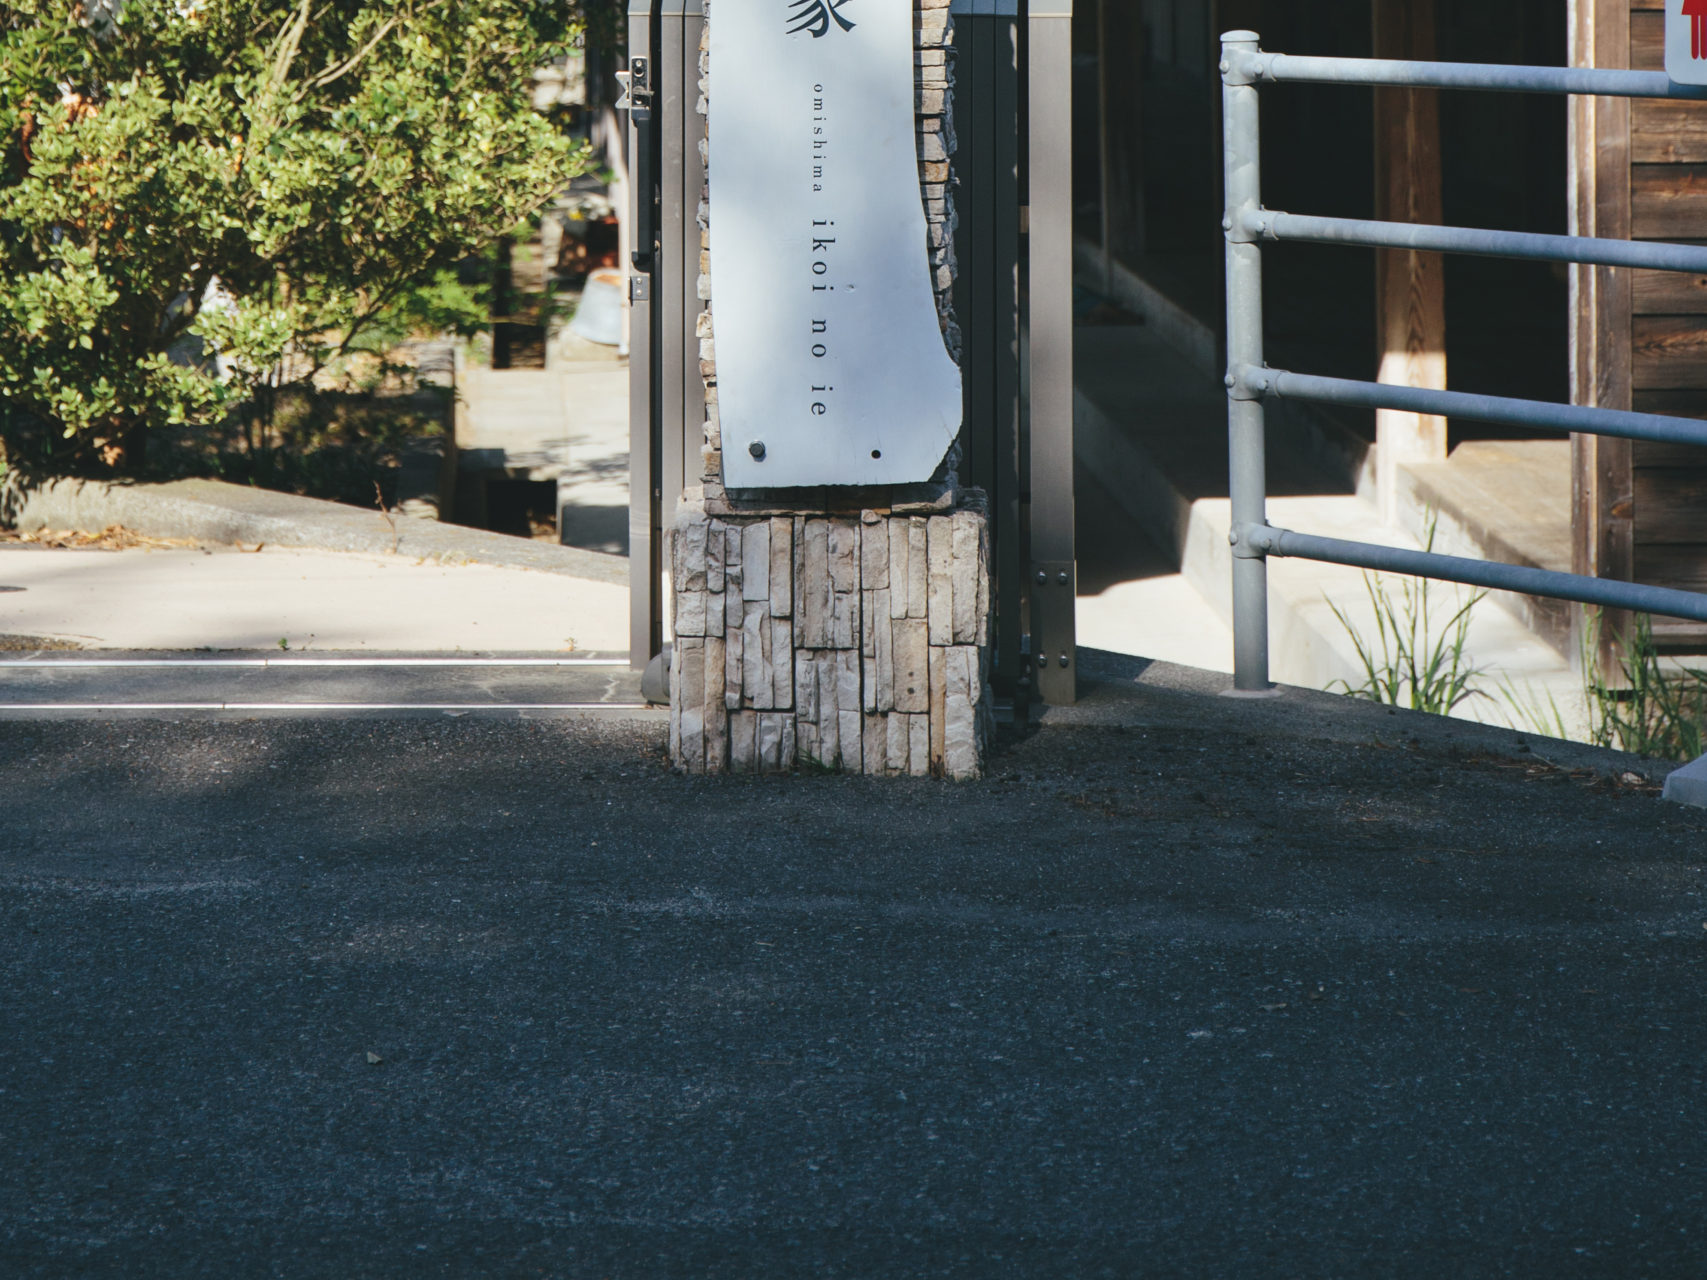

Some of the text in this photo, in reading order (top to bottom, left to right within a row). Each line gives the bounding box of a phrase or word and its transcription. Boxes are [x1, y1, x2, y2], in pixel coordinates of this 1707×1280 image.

[810, 83, 836, 417] omishima ikoi no ie
